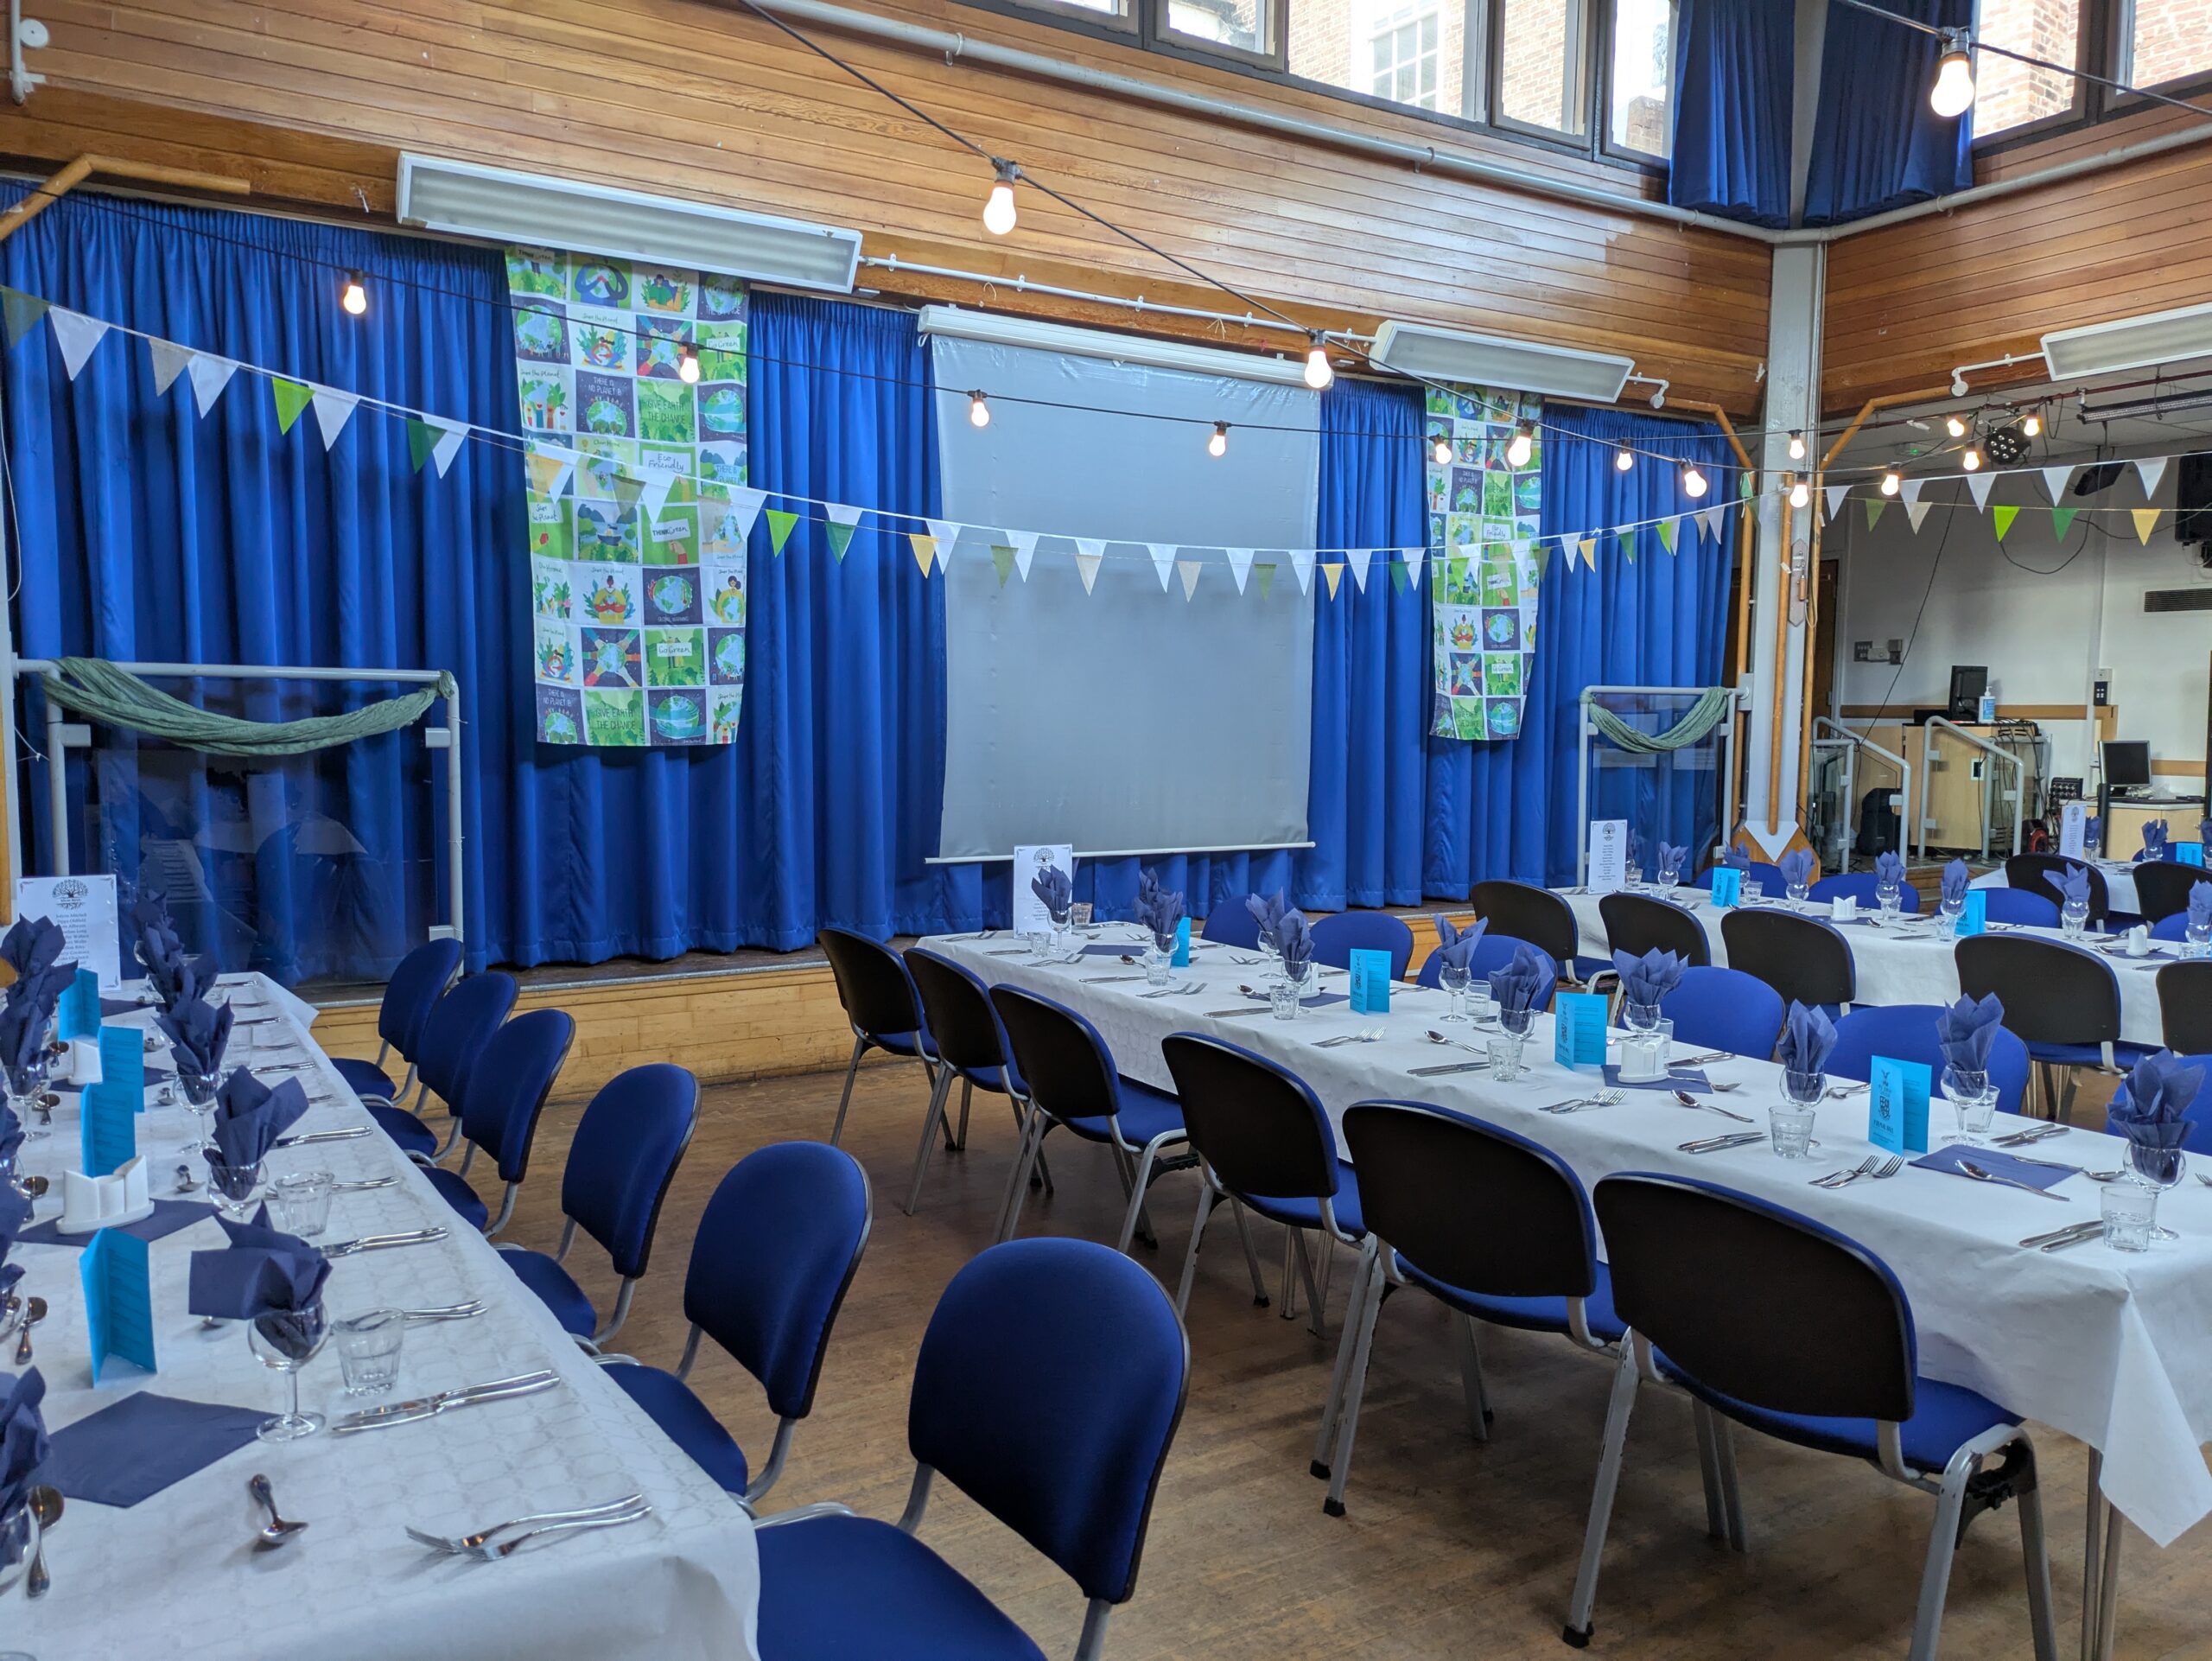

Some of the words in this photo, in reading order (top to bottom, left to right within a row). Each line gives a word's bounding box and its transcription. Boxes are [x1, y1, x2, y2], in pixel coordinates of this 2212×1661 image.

[594, 377, 608, 386] THERE
[596, 385, 616, 395] PLANET
[664, 402, 685, 410] EARTH
[648, 412, 659, 422] THE
[648, 460, 684, 474] Friendly
[596, 708, 611, 717] GIVE
[612, 708, 634, 717] EARTH
[596, 721, 608, 729] THE
